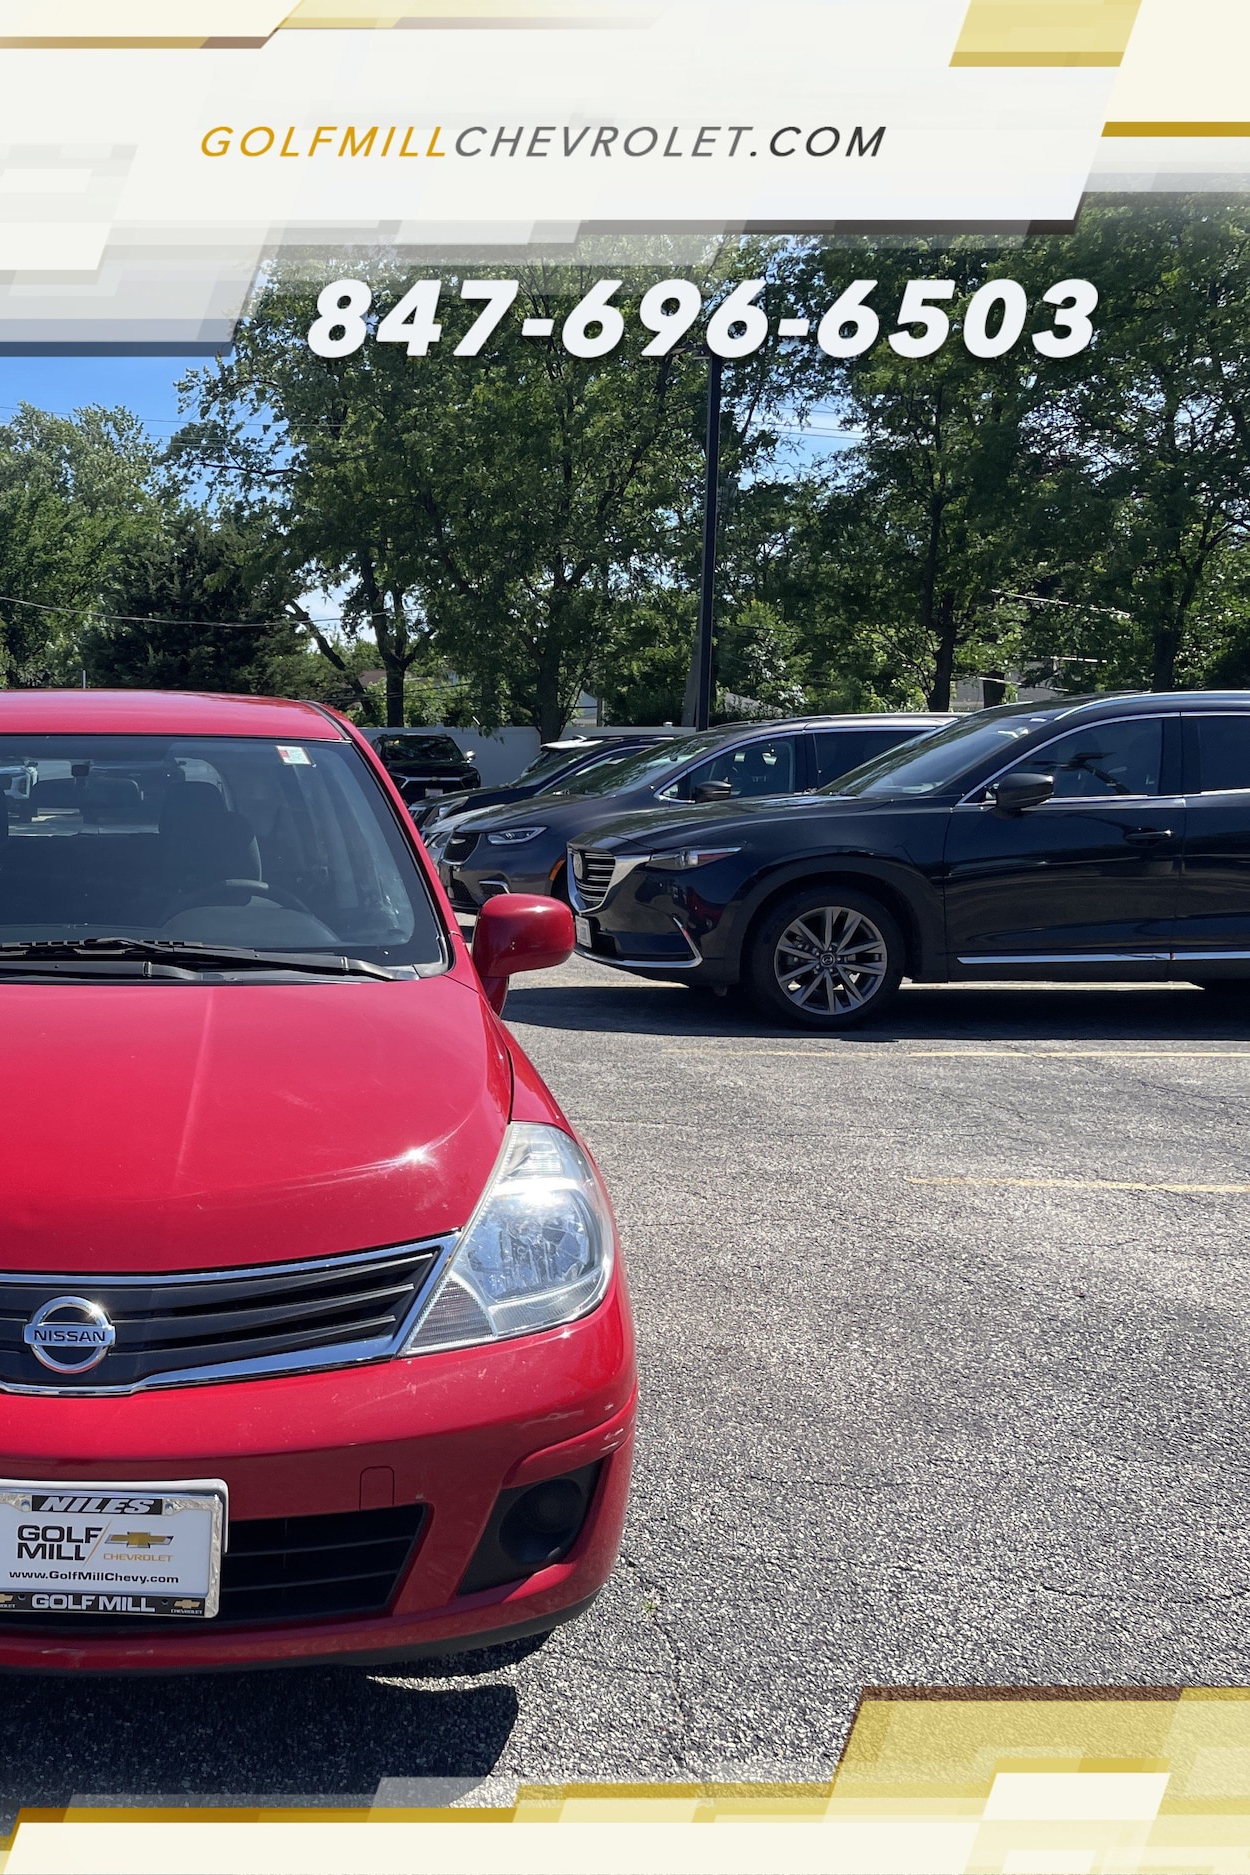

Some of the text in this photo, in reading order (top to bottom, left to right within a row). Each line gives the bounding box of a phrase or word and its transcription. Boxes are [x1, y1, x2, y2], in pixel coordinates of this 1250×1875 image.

[34, 1329, 105, 1342] NISSAN
[39, 1496, 154, 1513] NILES
[17, 1524, 103, 1544] GOLF
[17, 1543, 86, 1561] MILL
[103, 1553, 173, 1562] CHEVROLET
[9, 1570, 179, 1584] www.GolfMillChevy.com
[32, 1593, 155, 1612] GOLF MILL
